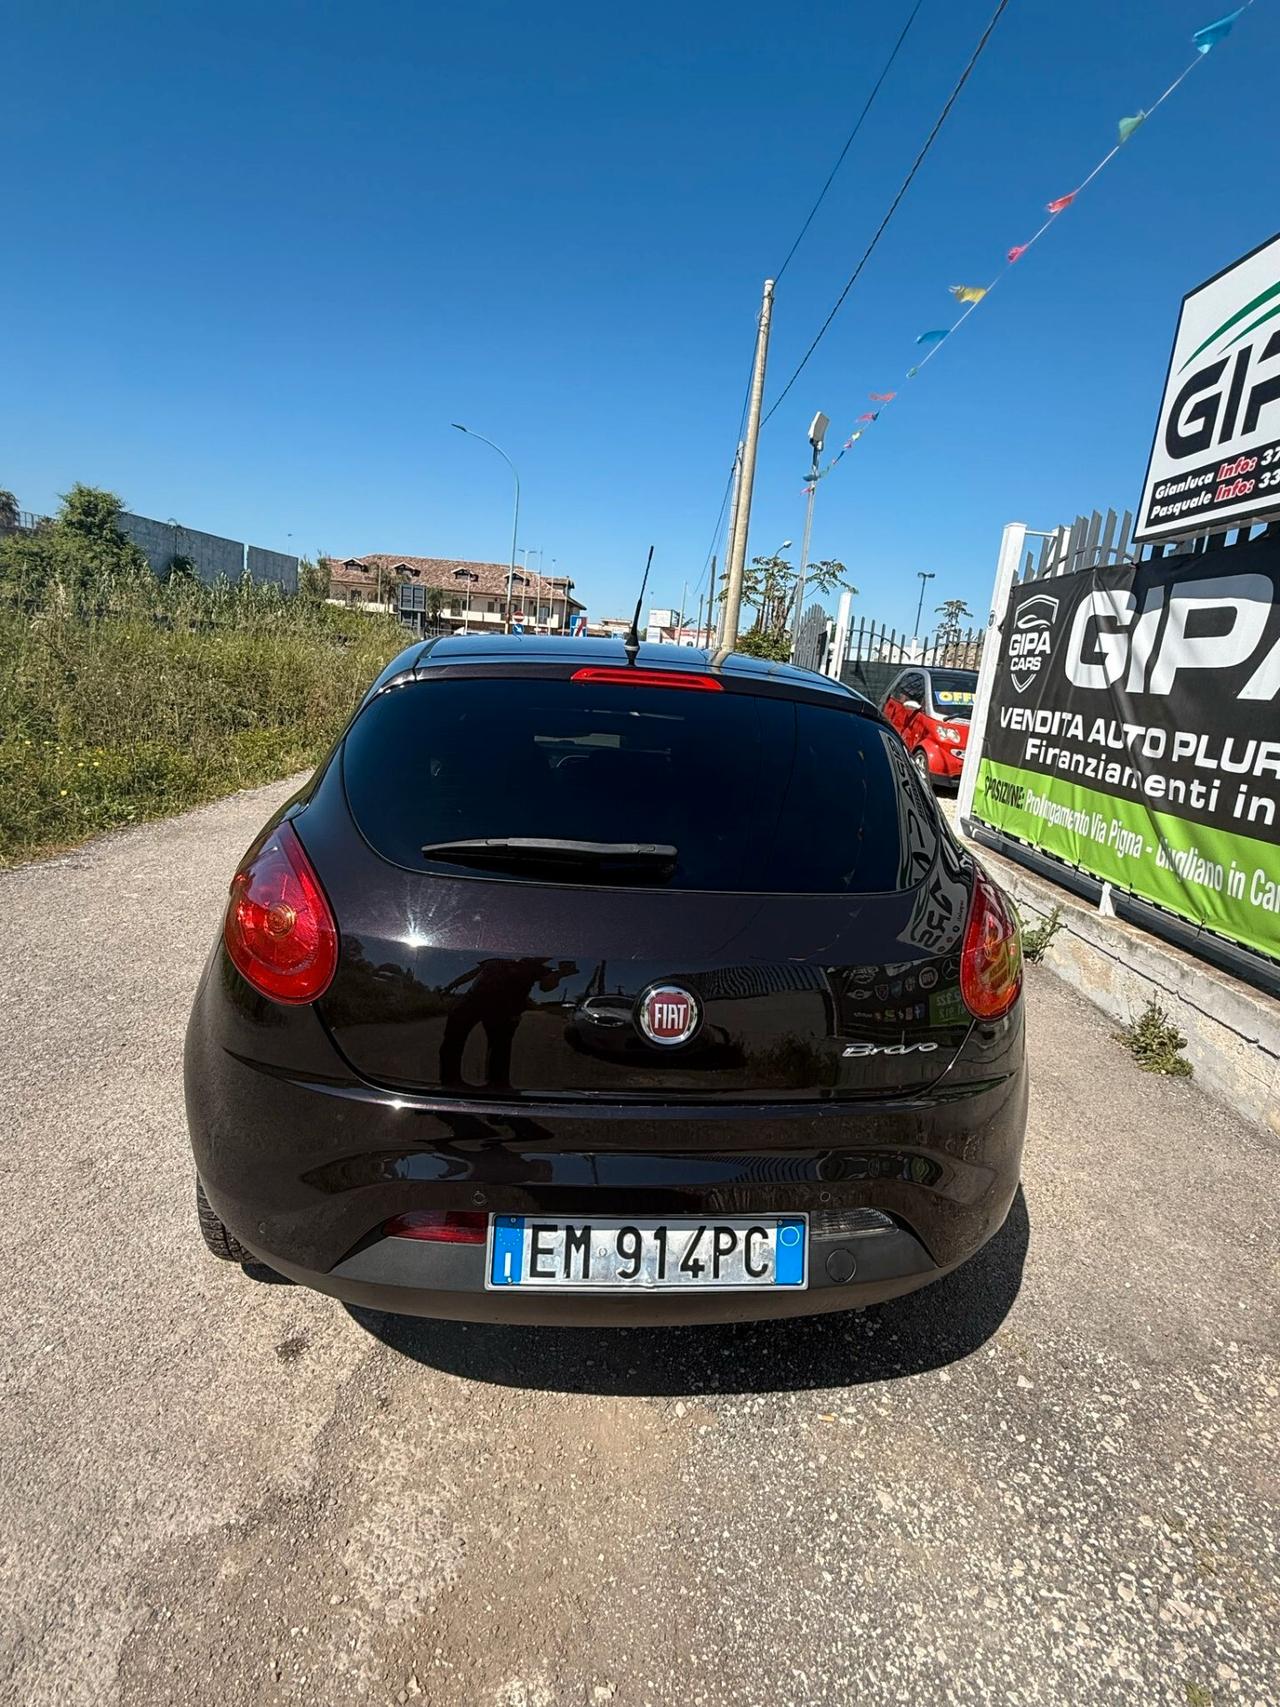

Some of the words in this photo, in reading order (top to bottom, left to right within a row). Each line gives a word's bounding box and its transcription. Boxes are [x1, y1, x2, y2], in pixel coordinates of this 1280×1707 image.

[1150, 491, 1212, 520] Pasquale
[1213, 478, 1255, 503] Info:
[1155, 472, 1215, 500] Gianluca
[1216, 456, 1258, 482] Info:
[1008, 631, 1051, 656] GIPA
[1010, 656, 1042, 671] CARS
[938, 691, 976, 702] OFF
[1000, 706, 1084, 741] VENDITA
[1087, 717, 1167, 759] AUTO
[1233, 783, 1276, 826] in
[1091, 811, 1106, 845] Via
[1107, 816, 1144, 859] Pigna
[1227, 860, 1246, 900] in
[654, 1003, 687, 1030] FIAT
[842, 1042, 939, 1057] Bravo
[529, 1224, 592, 1280] EM
[615, 1225, 770, 1280] 914PC
